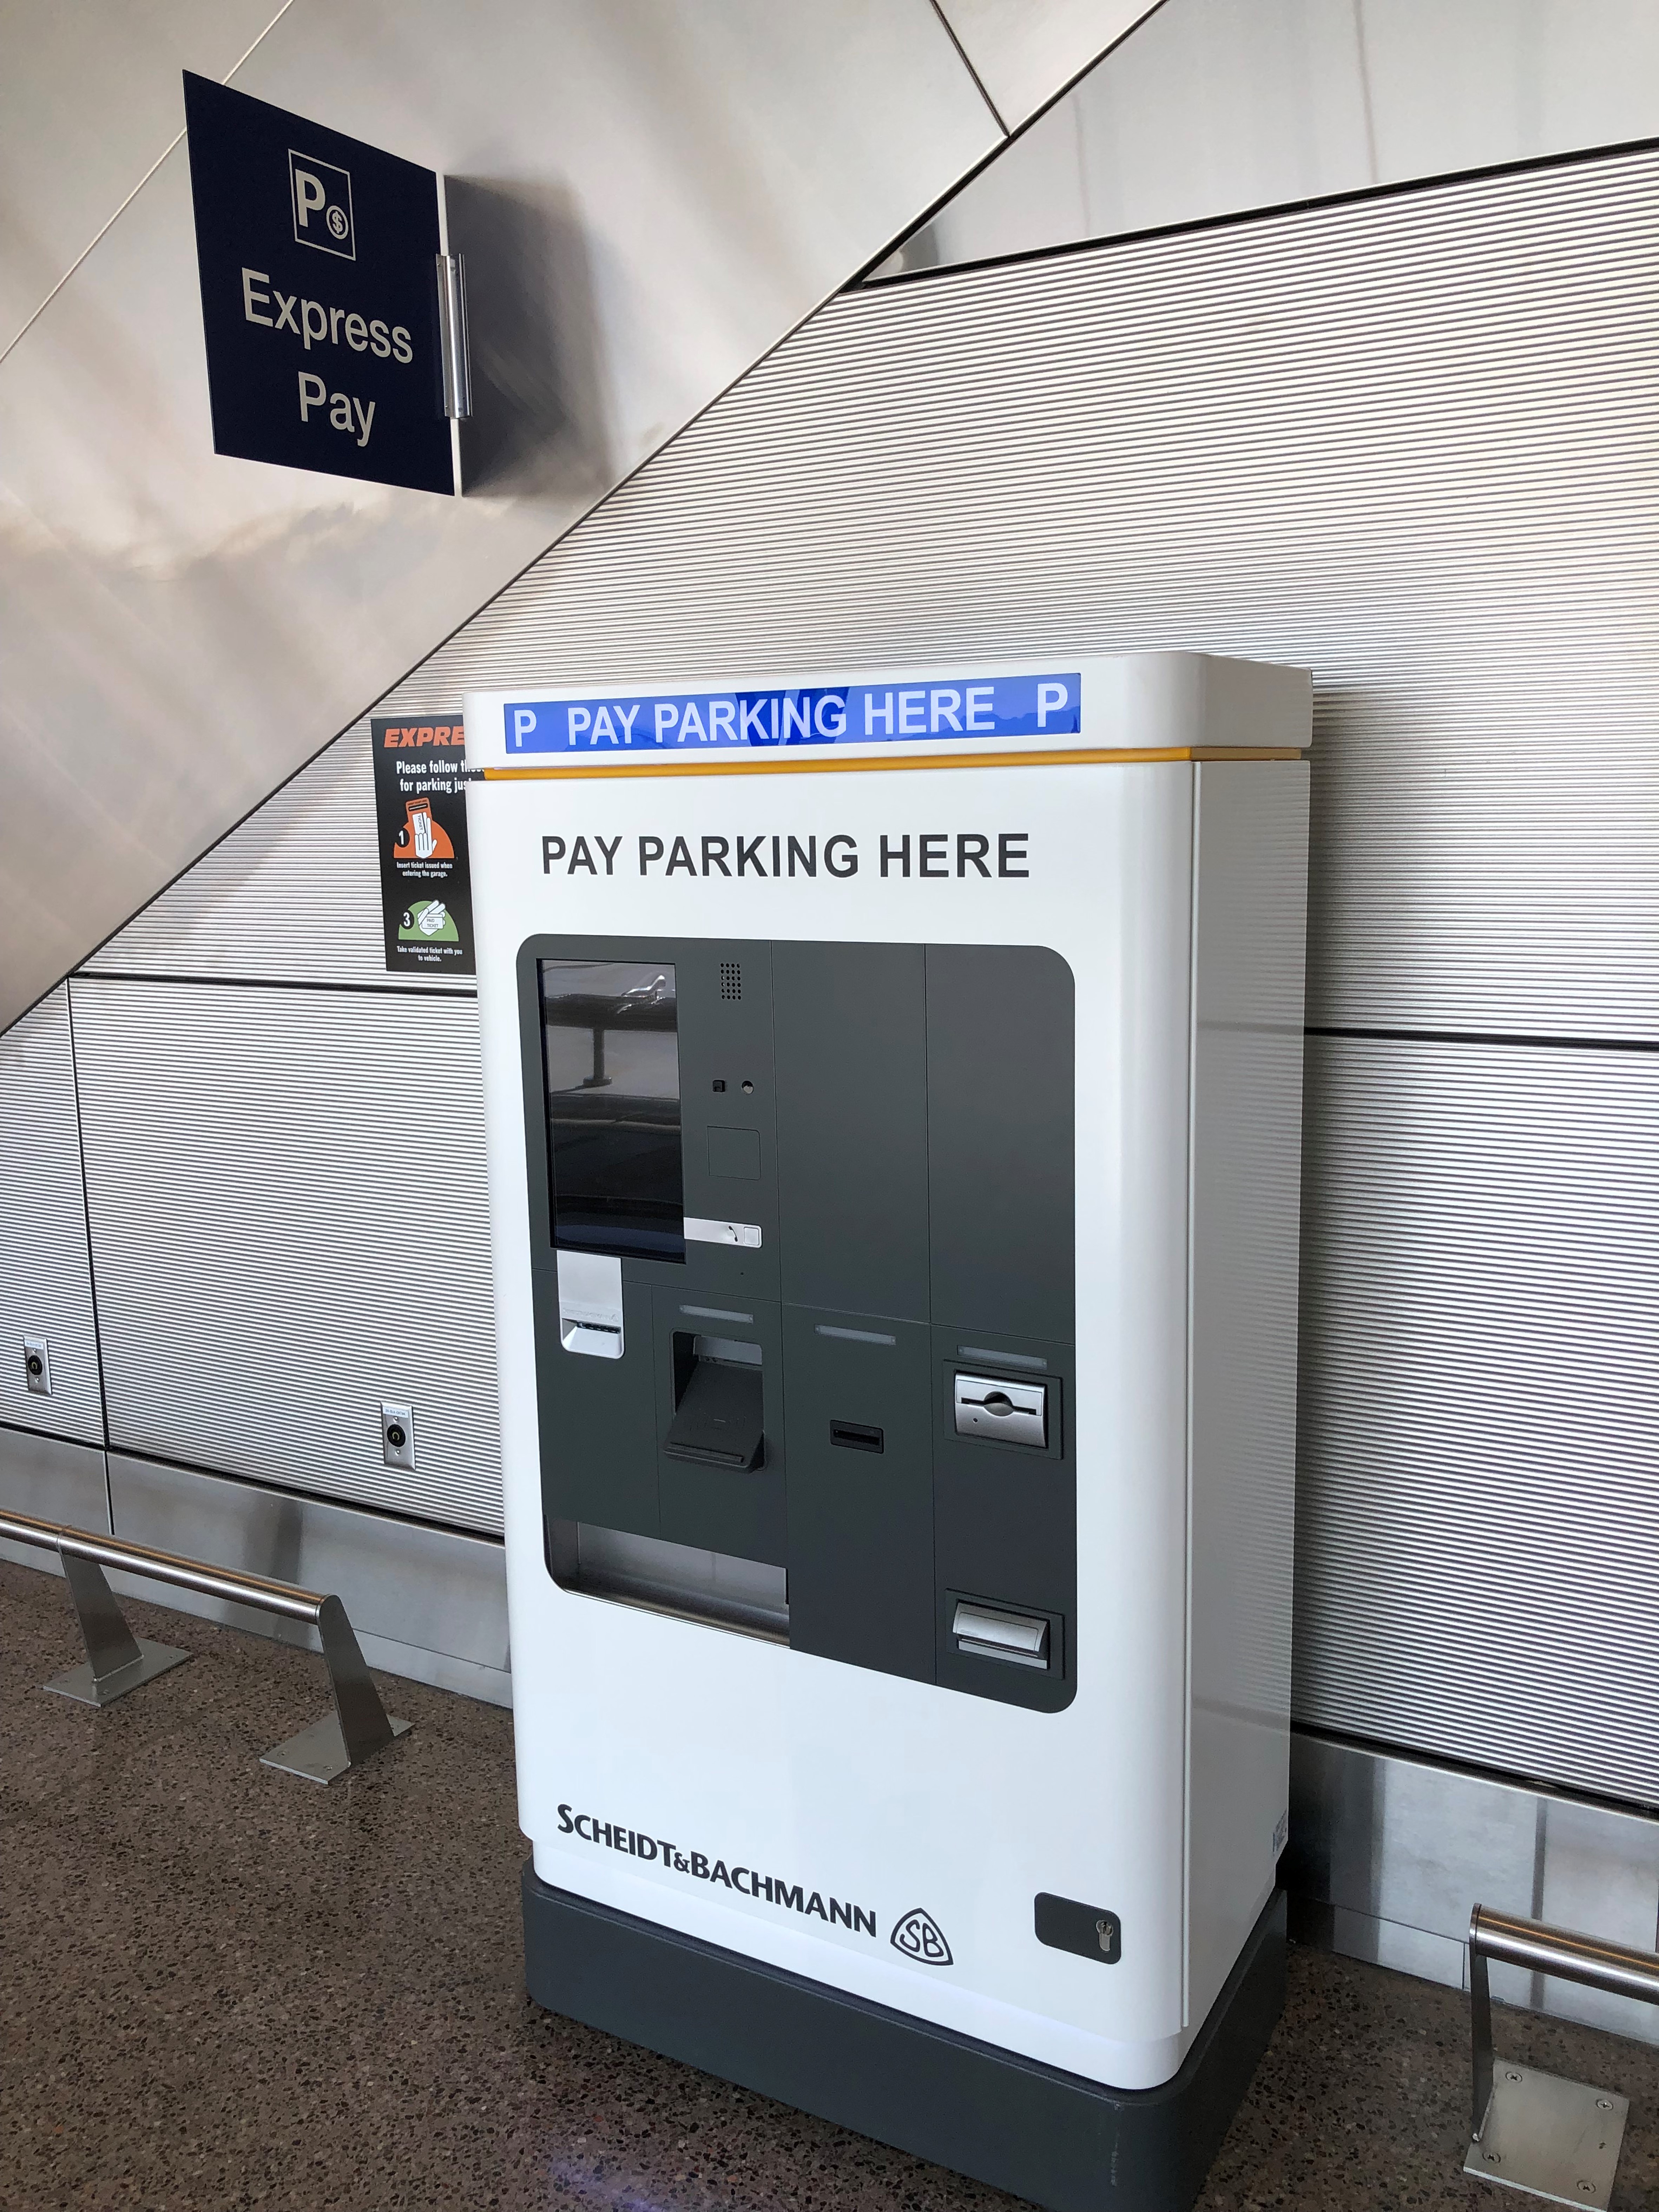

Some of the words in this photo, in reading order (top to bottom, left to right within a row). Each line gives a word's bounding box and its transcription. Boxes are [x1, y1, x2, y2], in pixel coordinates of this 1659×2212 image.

[295, 169, 325, 228] P
[242, 267, 413, 363] Express
[298, 371, 376, 447] Pay
[514, 710, 536, 747] P
[568, 705, 640, 745] PAY
[654, 695, 846, 743] PARKING
[864, 686, 995, 735] HERE
[1037, 683, 1068, 727] P
[396, 761, 427, 774] Please
[429, 759, 458, 773] follow
[400, 778, 414, 791] for
[416, 778, 452, 794] parking
[399, 830, 404, 845] 1
[542, 836, 623, 875] PAY
[639, 835, 858, 878] PARKING
[880, 833, 1029, 878] HERE
[403, 912, 411, 927] 3
[899, 1919, 944, 1958] SB
